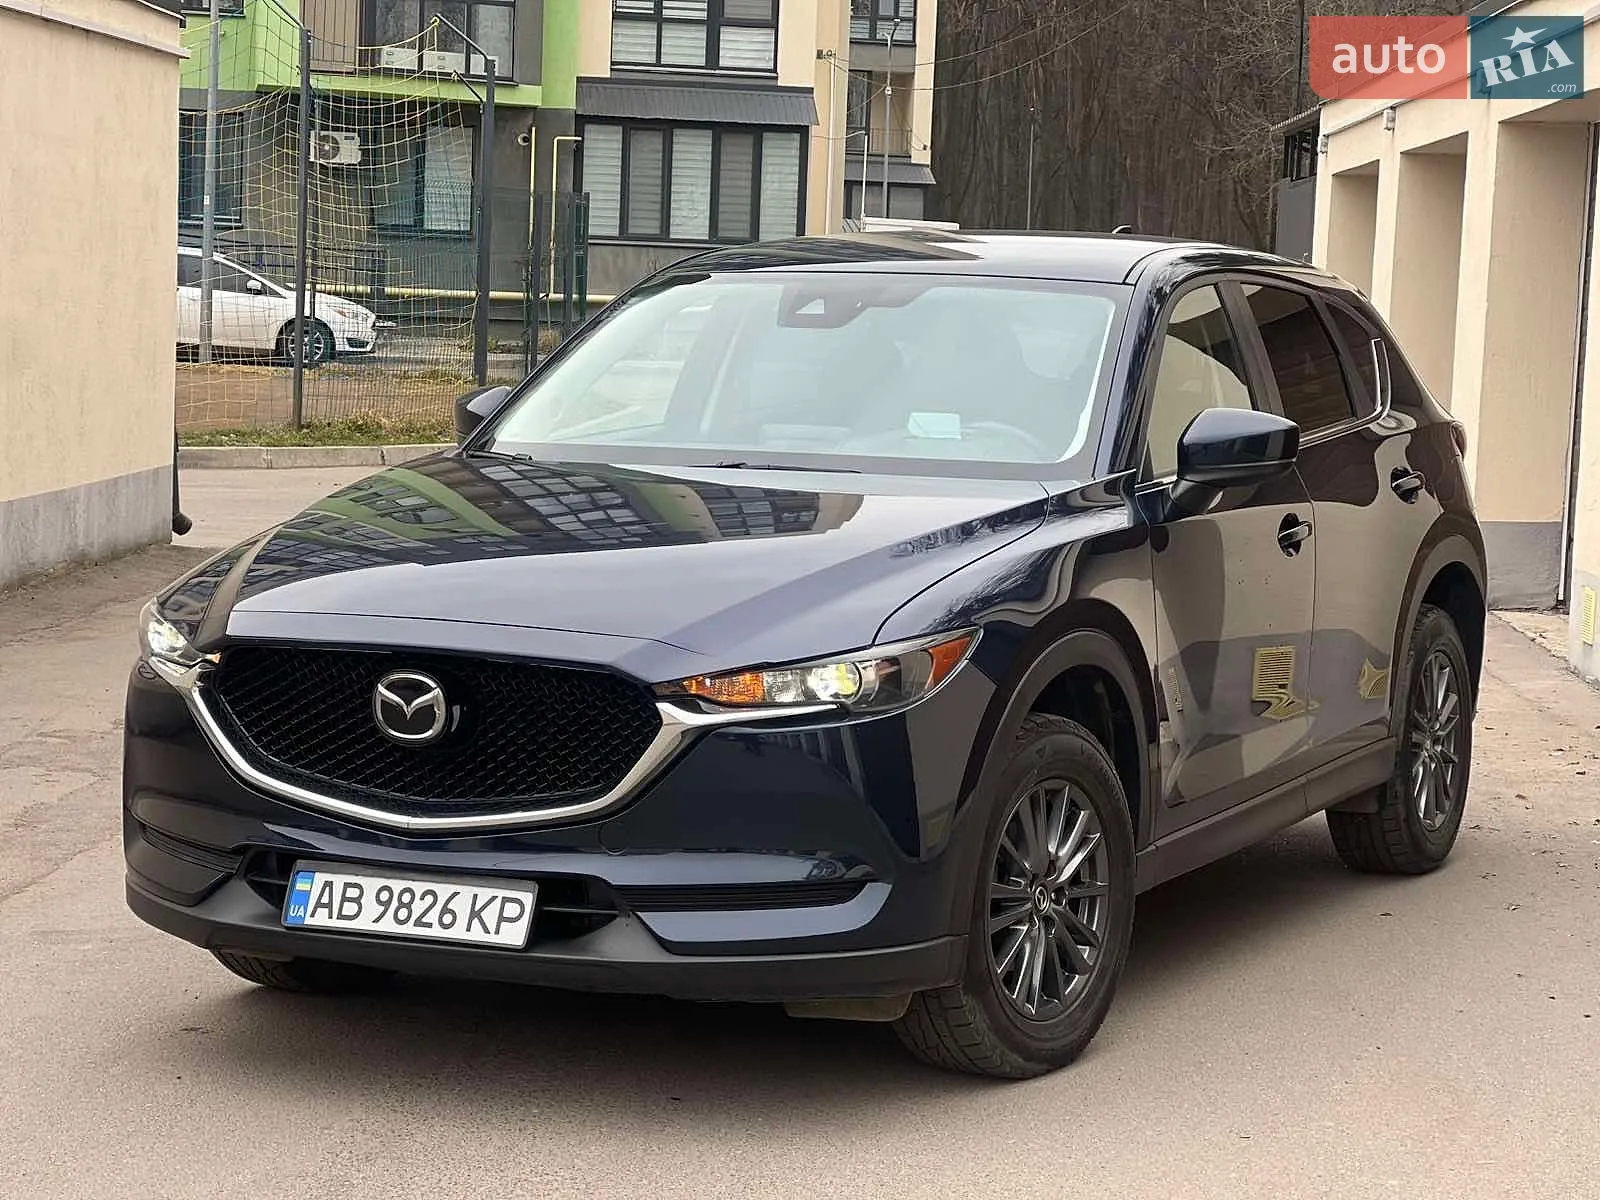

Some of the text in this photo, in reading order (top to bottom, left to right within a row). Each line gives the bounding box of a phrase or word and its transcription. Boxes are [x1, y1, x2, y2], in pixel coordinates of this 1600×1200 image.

[289, 904, 305, 918] UA
[309, 881, 526, 935] AB 9826 KP
